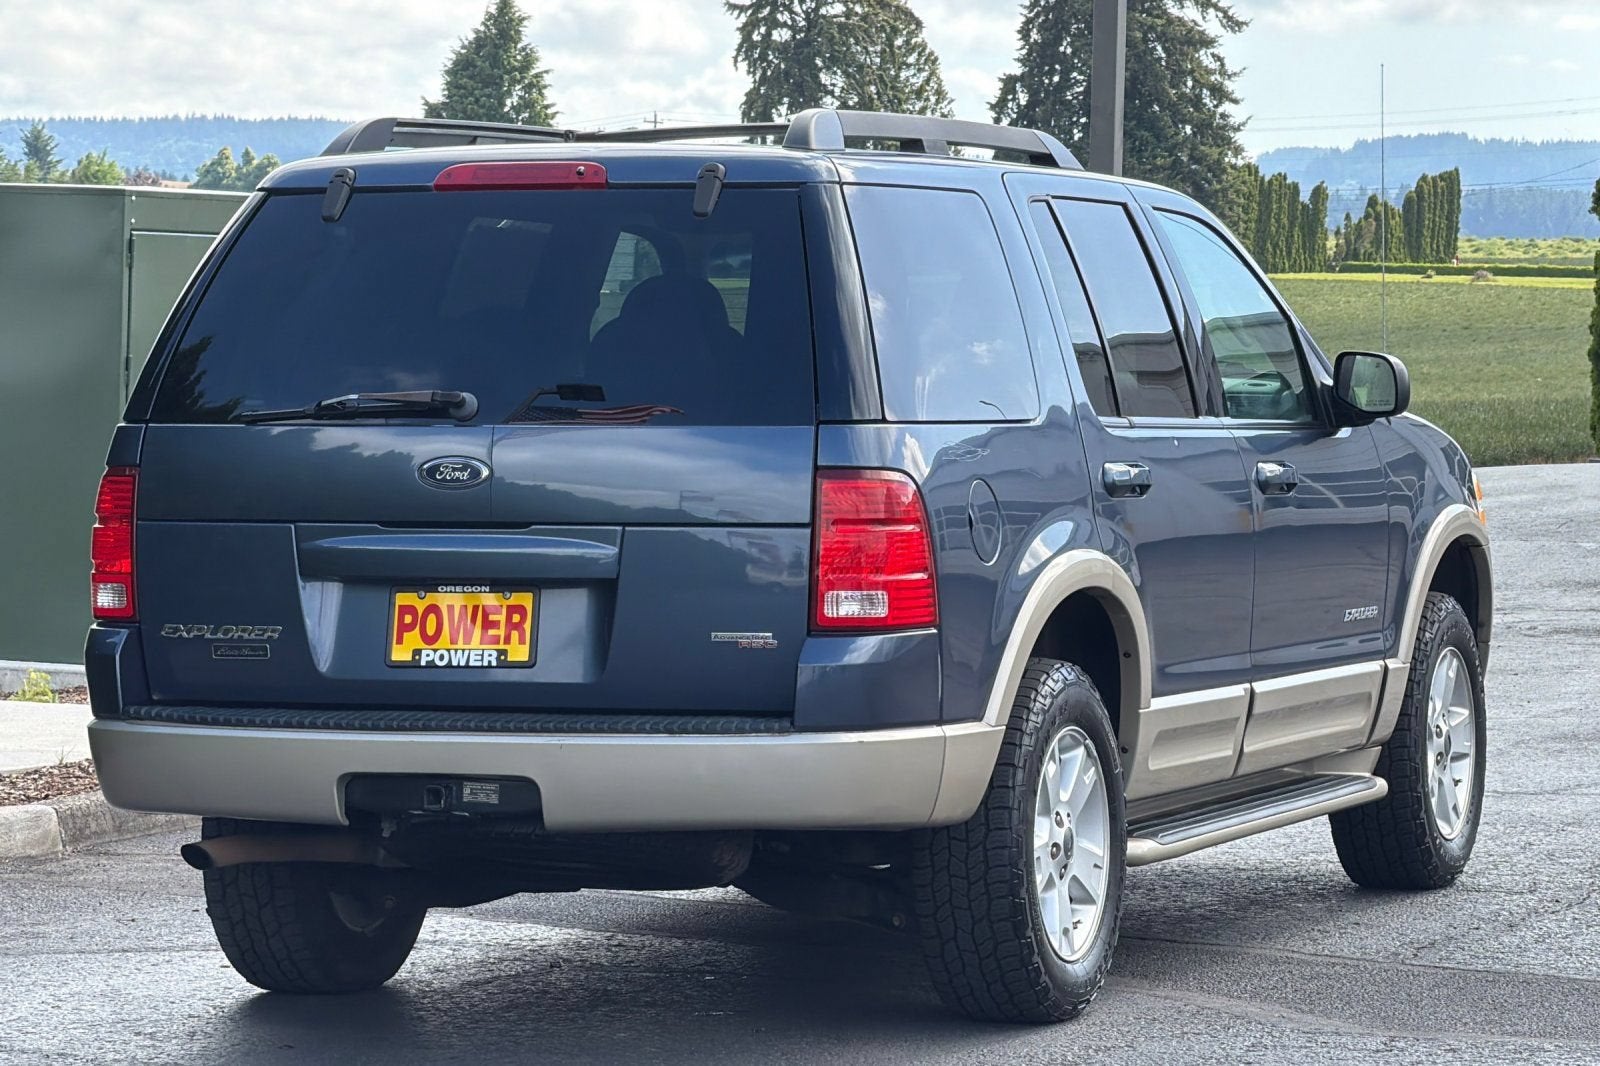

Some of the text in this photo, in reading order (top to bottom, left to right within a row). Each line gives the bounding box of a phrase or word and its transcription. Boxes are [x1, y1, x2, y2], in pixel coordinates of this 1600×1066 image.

[435, 463, 471, 480] Ford
[437, 585, 490, 593] OREGON
[160, 623, 283, 640] EXPLORER
[395, 603, 528, 647] POWER
[420, 649, 498, 667] POWER
